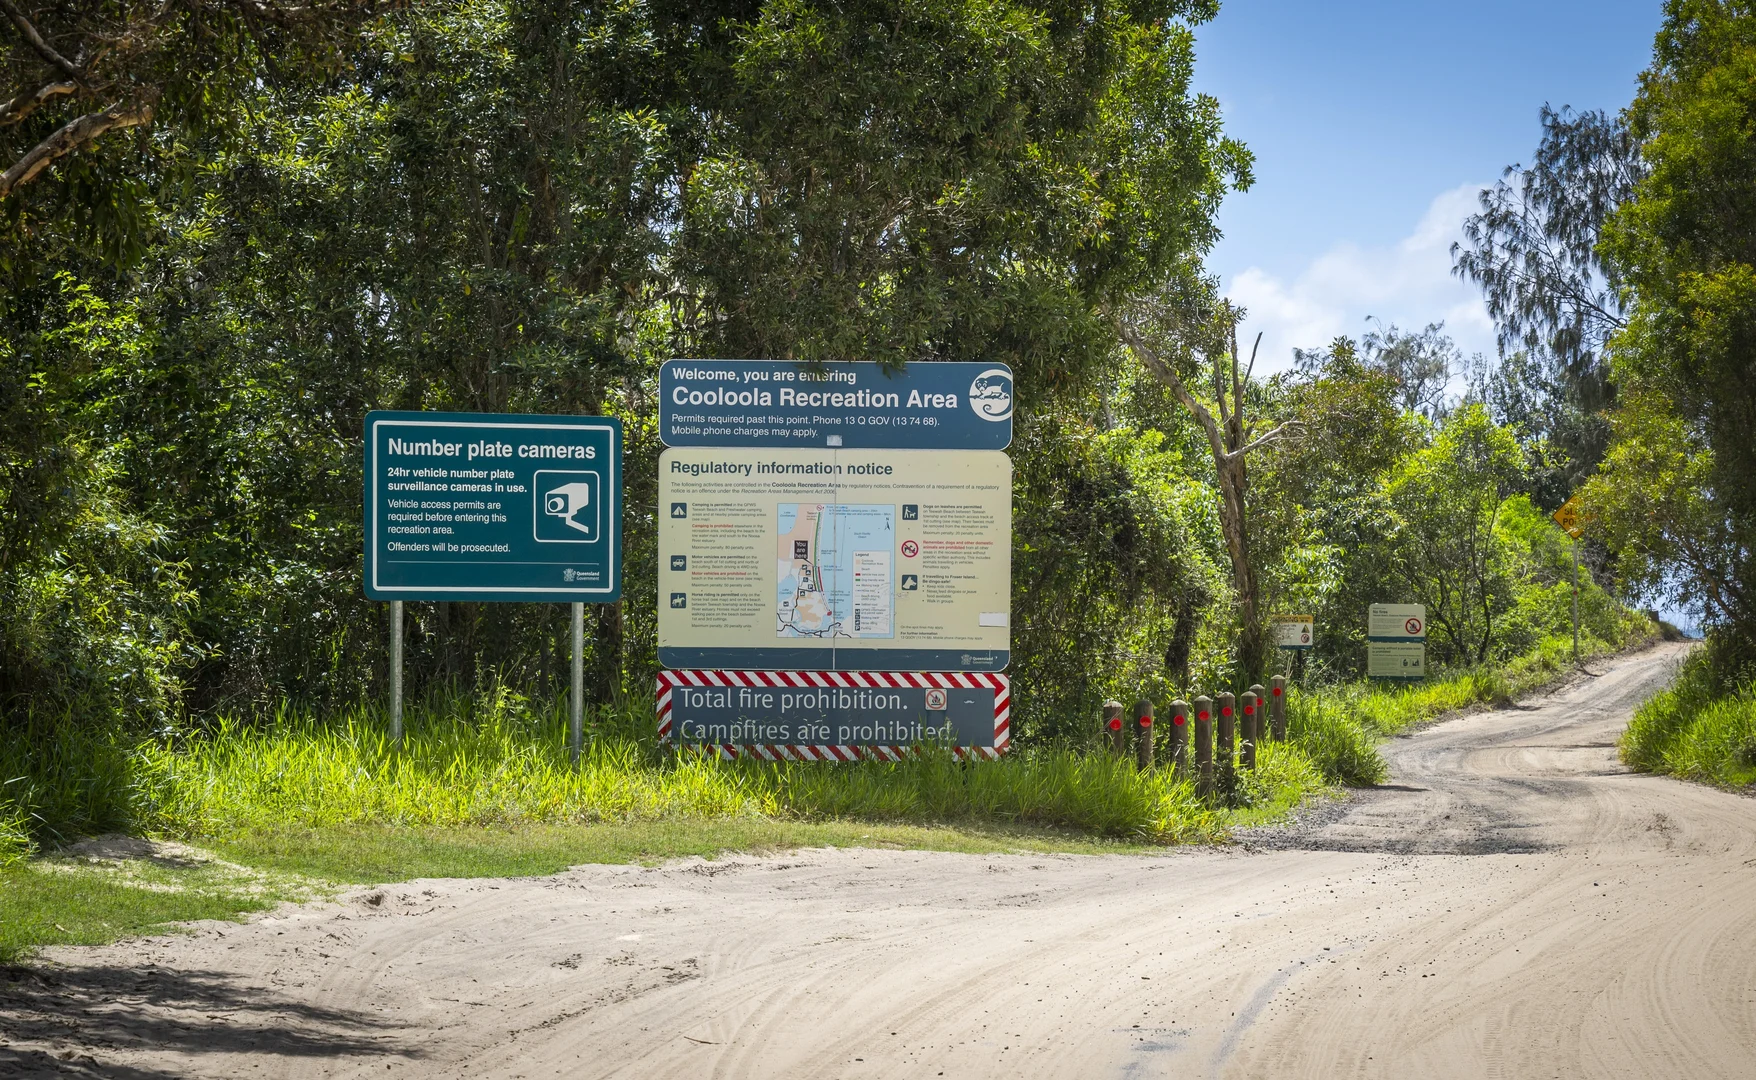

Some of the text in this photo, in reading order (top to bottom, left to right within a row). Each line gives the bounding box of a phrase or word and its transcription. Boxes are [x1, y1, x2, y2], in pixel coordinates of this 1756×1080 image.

[672, 367, 856, 385] Welcome, you are entering
[672, 386, 958, 408] Cooloola Recreation Area
[672, 414, 940, 427] Permits required past this point. Phone 13 Q GOV (13 74 68).
[672, 425, 818, 438] Mobile phone charges may apply.
[388, 437, 596, 462] Number plate cameras
[387, 467, 514, 481] 24hr vehicle number plate
[671, 460, 893, 477] Regulatory information notice
[387, 481, 447, 491] surveillance
[494, 482, 504, 492] in
[388, 499, 419, 508] Vehicle
[453, 500, 485, 511] permits
[388, 512, 506, 524] required before entering this
[388, 525, 430, 534] recreation
[388, 542, 511, 554] Offenders will be prosecuted.
[680, 687, 908, 715] Total fire prohibition.
[680, 718, 789, 745] Campfires
[794, 724, 830, 740] are
